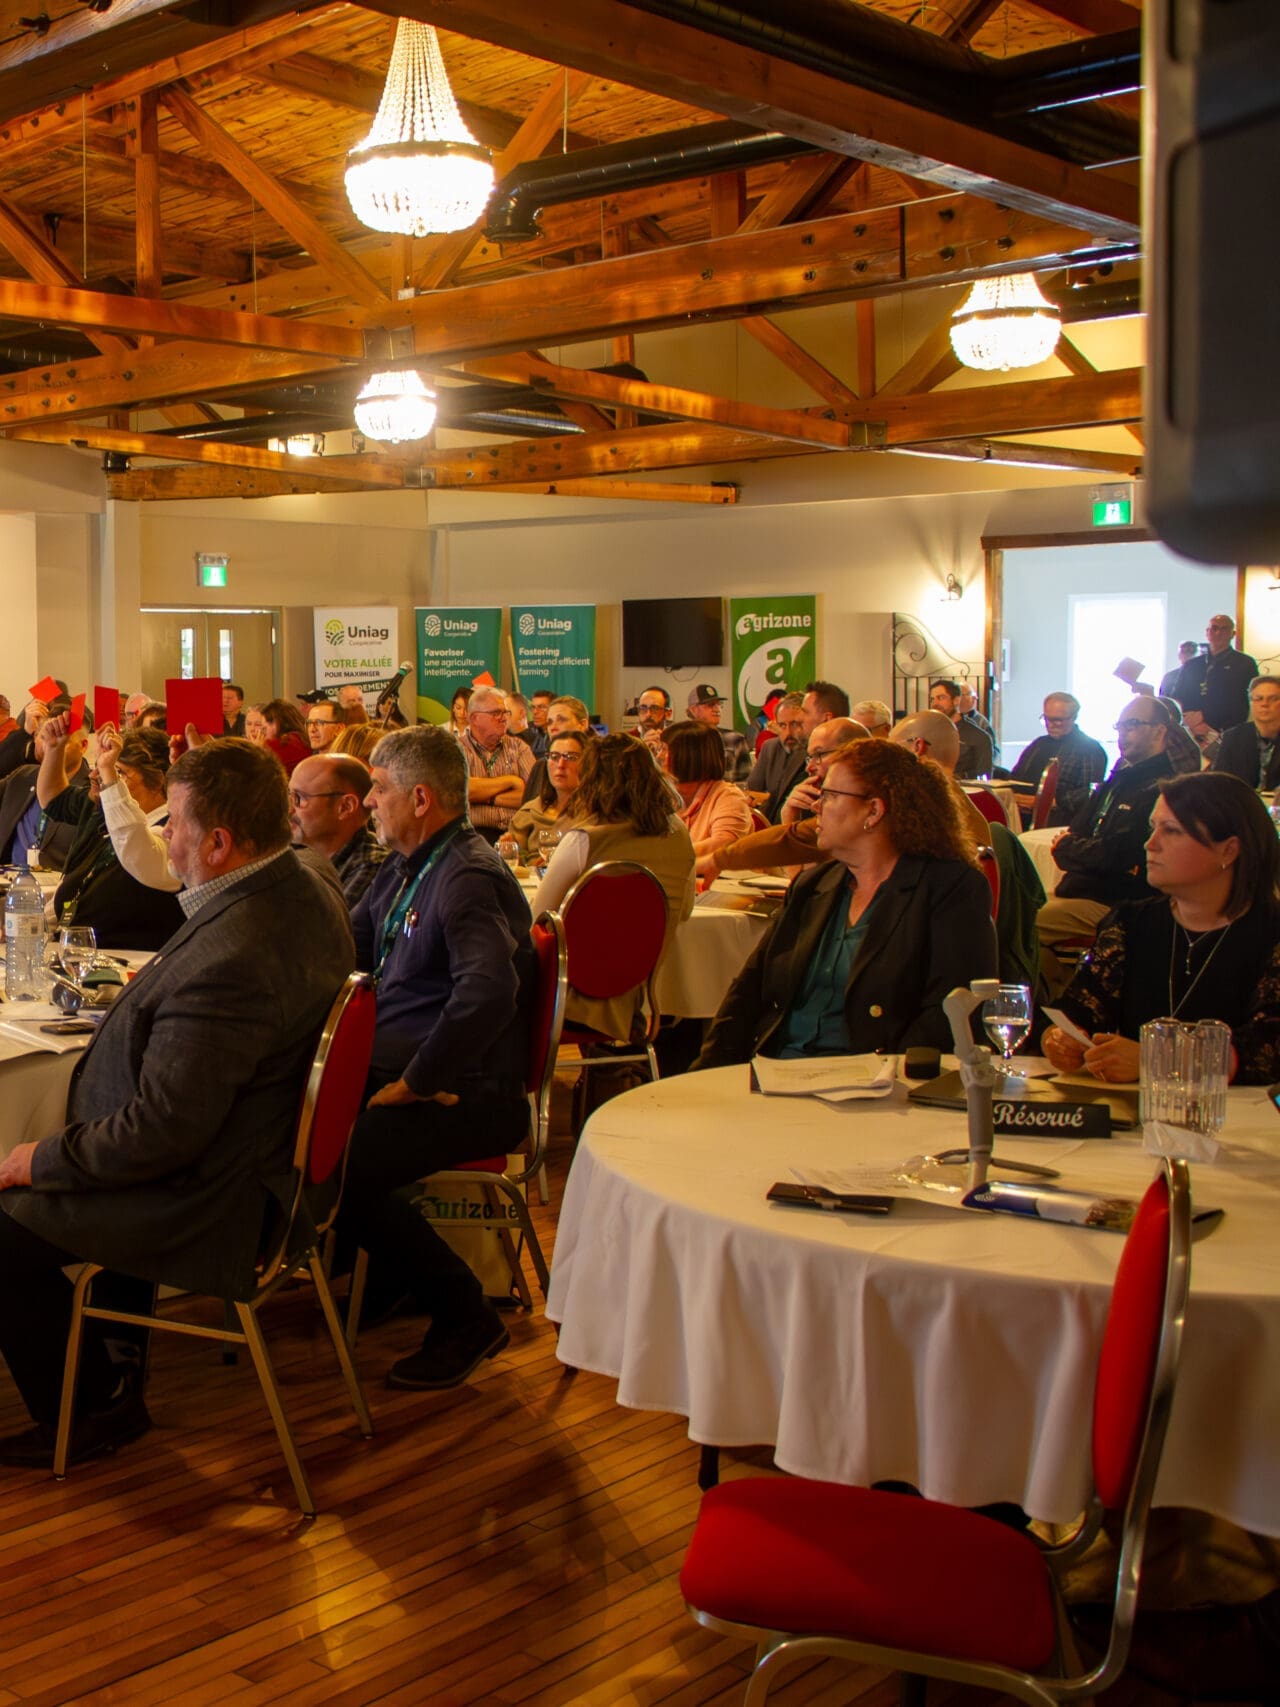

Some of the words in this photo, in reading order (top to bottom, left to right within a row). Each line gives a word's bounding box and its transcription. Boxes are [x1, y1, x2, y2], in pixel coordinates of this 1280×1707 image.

[443, 619, 478, 633] Uniag
[538, 618, 572, 632] Uniag
[347, 625, 389, 640] Uniag
[424, 648, 465, 657] Favoriser
[519, 647, 560, 657] Fostering
[323, 658, 359, 668] VOTRE
[360, 656, 393, 668] ALLIÉE
[441, 658, 486, 668] agriculture
[519, 658, 541, 666] smart
[542, 657, 558, 666] and
[558, 656, 591, 666] efficient
[343, 670, 380, 678] MAXIMISER
[424, 668, 473, 678] intelligente.
[519, 668, 549, 678] farming
[992, 1102, 1084, 1128] Réservé
